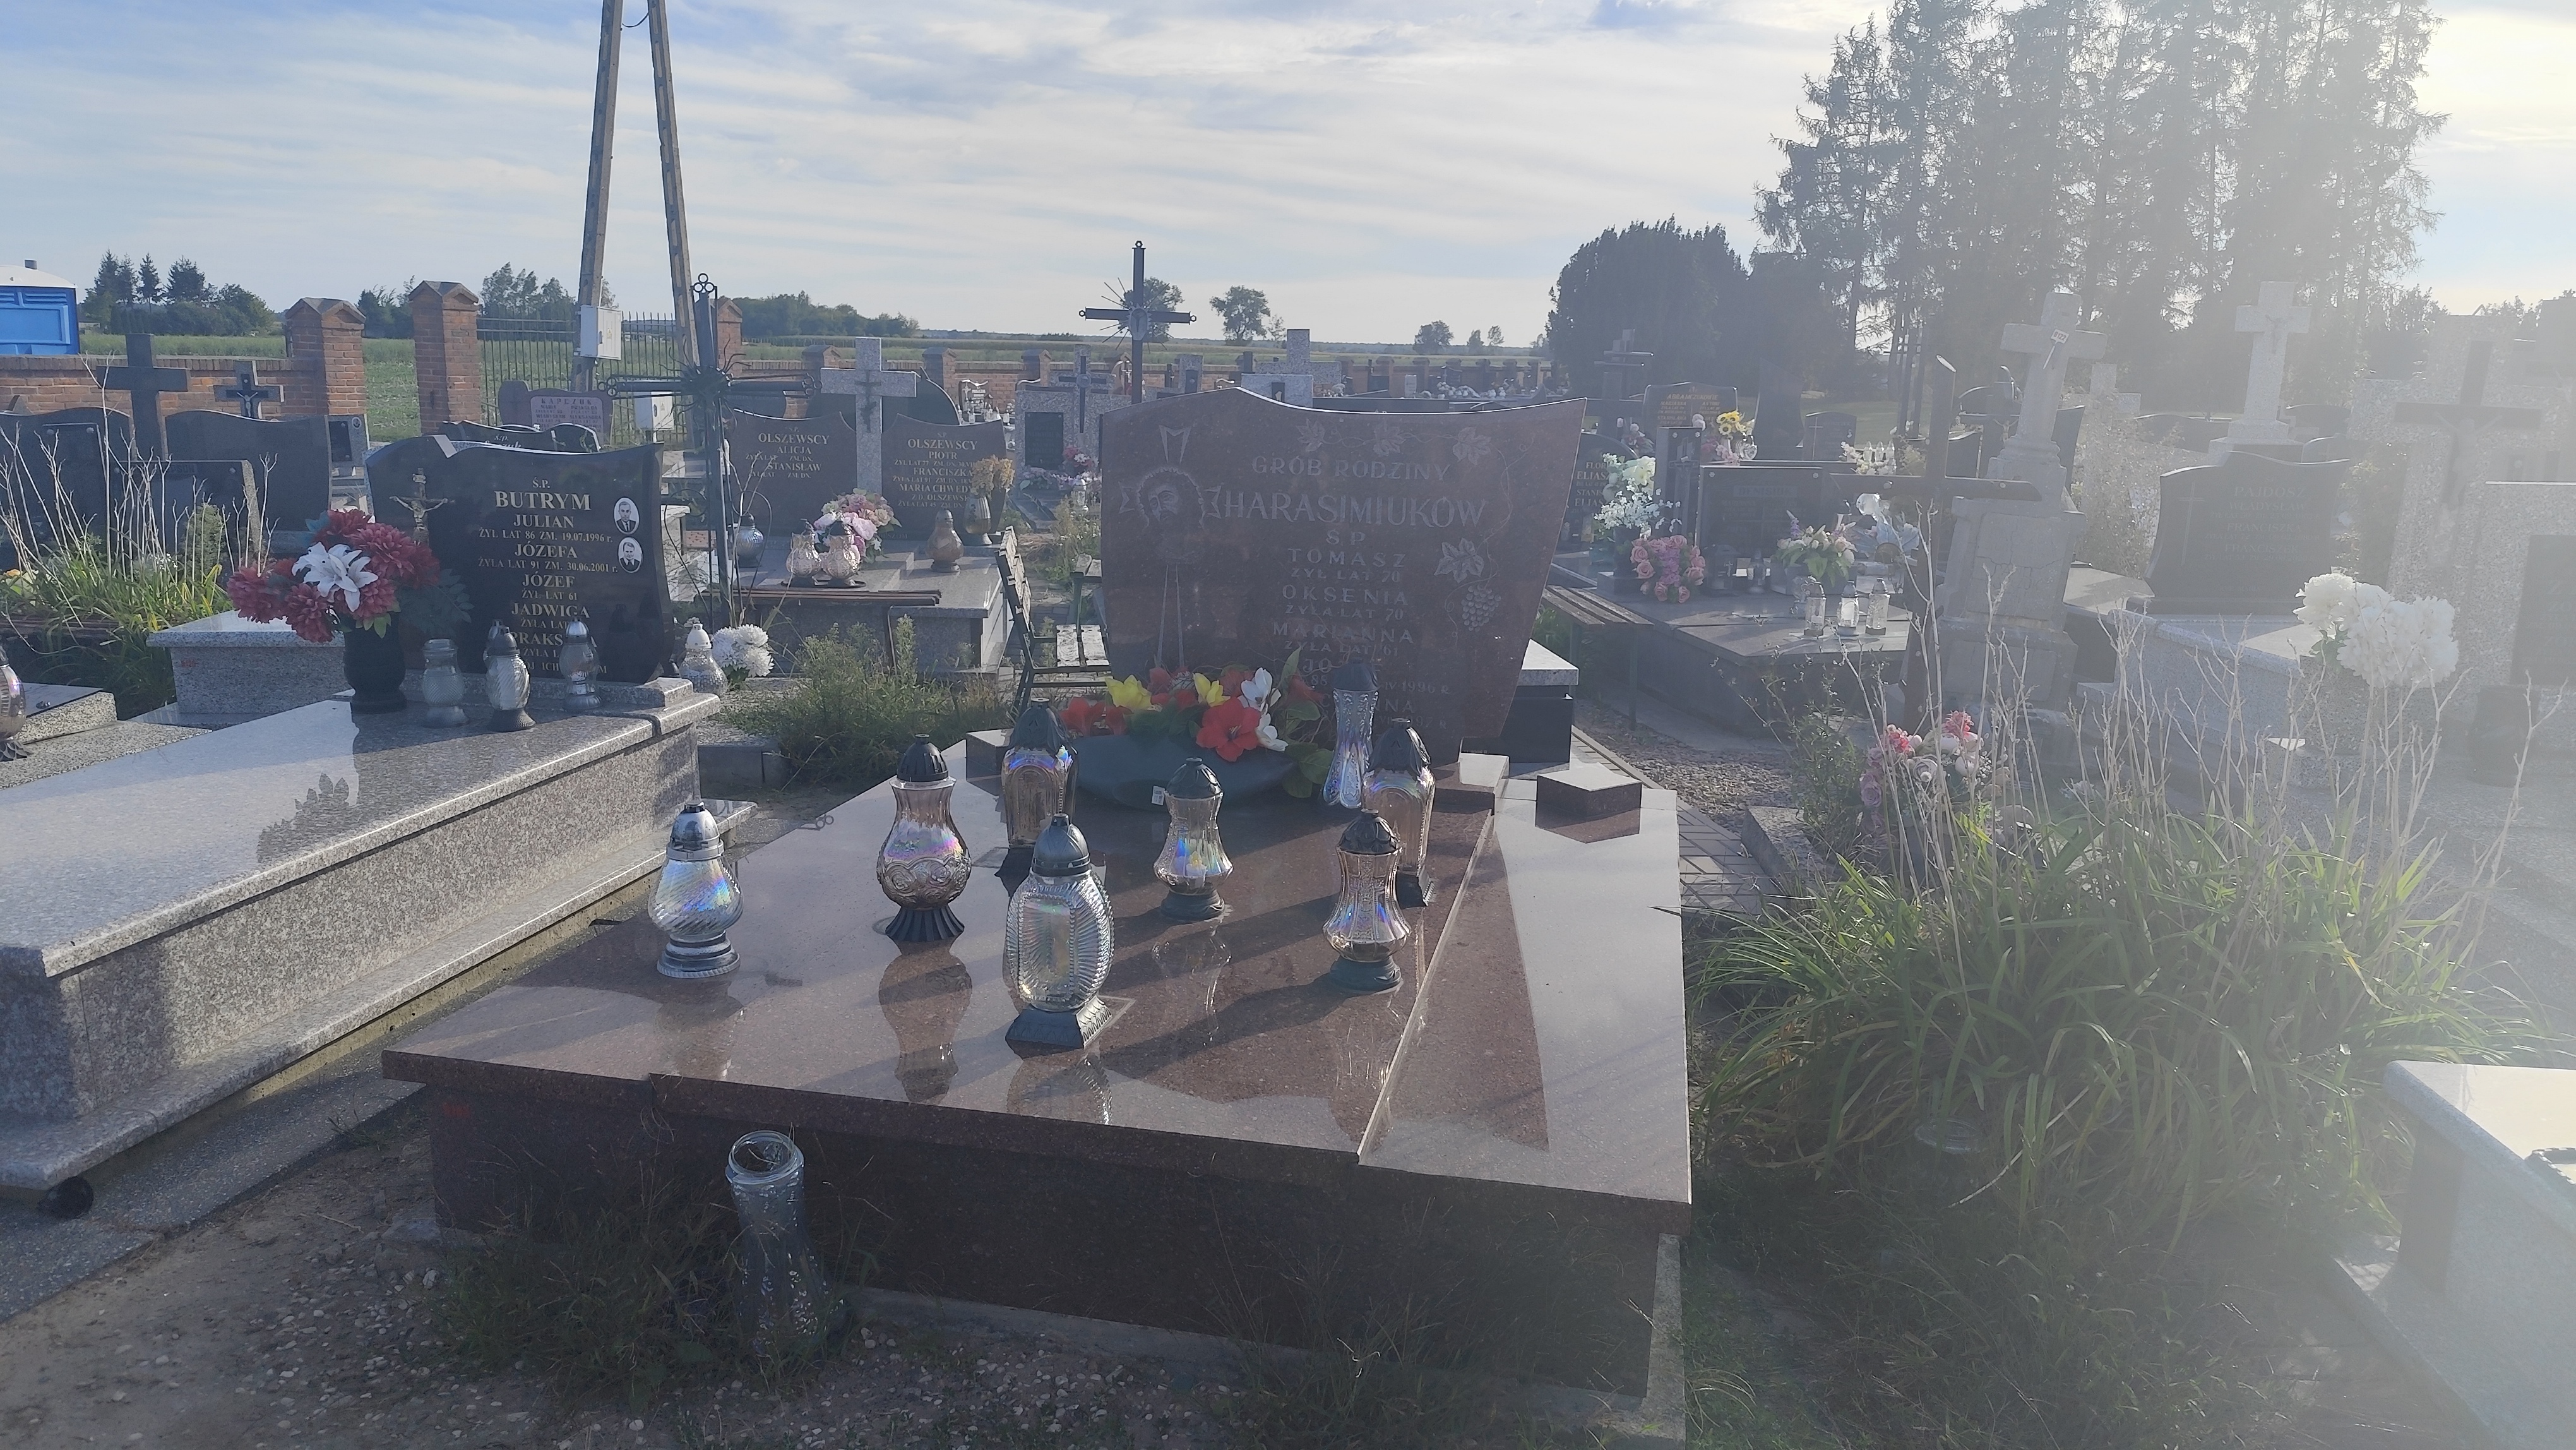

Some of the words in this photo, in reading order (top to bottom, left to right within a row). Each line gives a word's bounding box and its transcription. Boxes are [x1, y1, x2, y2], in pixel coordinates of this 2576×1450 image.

[758, 433, 830, 445] OLSZEWSCY
[907, 438, 977, 450] OLSZEWSCY
[777, 446, 811, 454] ALICJA
[929, 451, 957, 459] PIOTR
[914, 467, 973, 476] FRANCISZKA
[1251, 455, 1321, 476] GRÓB
[1335, 460, 1450, 481] RODZINY
[532, 477, 551, 489] Ś.P.
[899, 483, 931, 492] MARIA
[2234, 486, 2306, 498] PAJDOSZ
[494, 491, 592, 511] BUTRYM
[1224, 491, 1489, 528] HARASIMIUKÓW
[513, 514, 575, 528] JULIAN
[2227, 523, 2302, 532] FRANCISZKA
[503, 530, 521, 539] LAT
[525, 531, 535, 539] 86
[539, 531, 558, 541] ZM.
[562, 532, 604, 542] 19.07.1996
[515, 541, 578, 558] JÓZEFA
[1287, 548, 1406, 567] TOMASZ
[478, 556, 504, 567] ŻYŁA
[508, 560, 527, 568] LAT
[530, 560, 540, 569] 91
[545, 561, 563, 570] ZM.
[567, 562, 609, 572] 30.06.2001
[522, 571, 575, 588] JÓZEF
[1337, 570, 1373, 580] LAT
[1381, 570, 1400, 582] 70
[546, 590, 564, 600] LAT
[568, 592, 578, 601] 61
[1282, 584, 1408, 606] OKSENIA
[511, 602, 590, 618] JADWIGA
[1341, 608, 1376, 618] LAT
[1386, 609, 1404, 621] 70
[521, 617, 547, 628] ŻYŁA
[551, 620, 568, 629] LAT
[1273, 621, 1414, 644] MARIANNA
[511, 632, 597, 648] PRAKS
[523, 646, 549, 657] ŻYŁA
[1339, 645, 1371, 655] LAT
[542, 662, 559, 671] ICH
